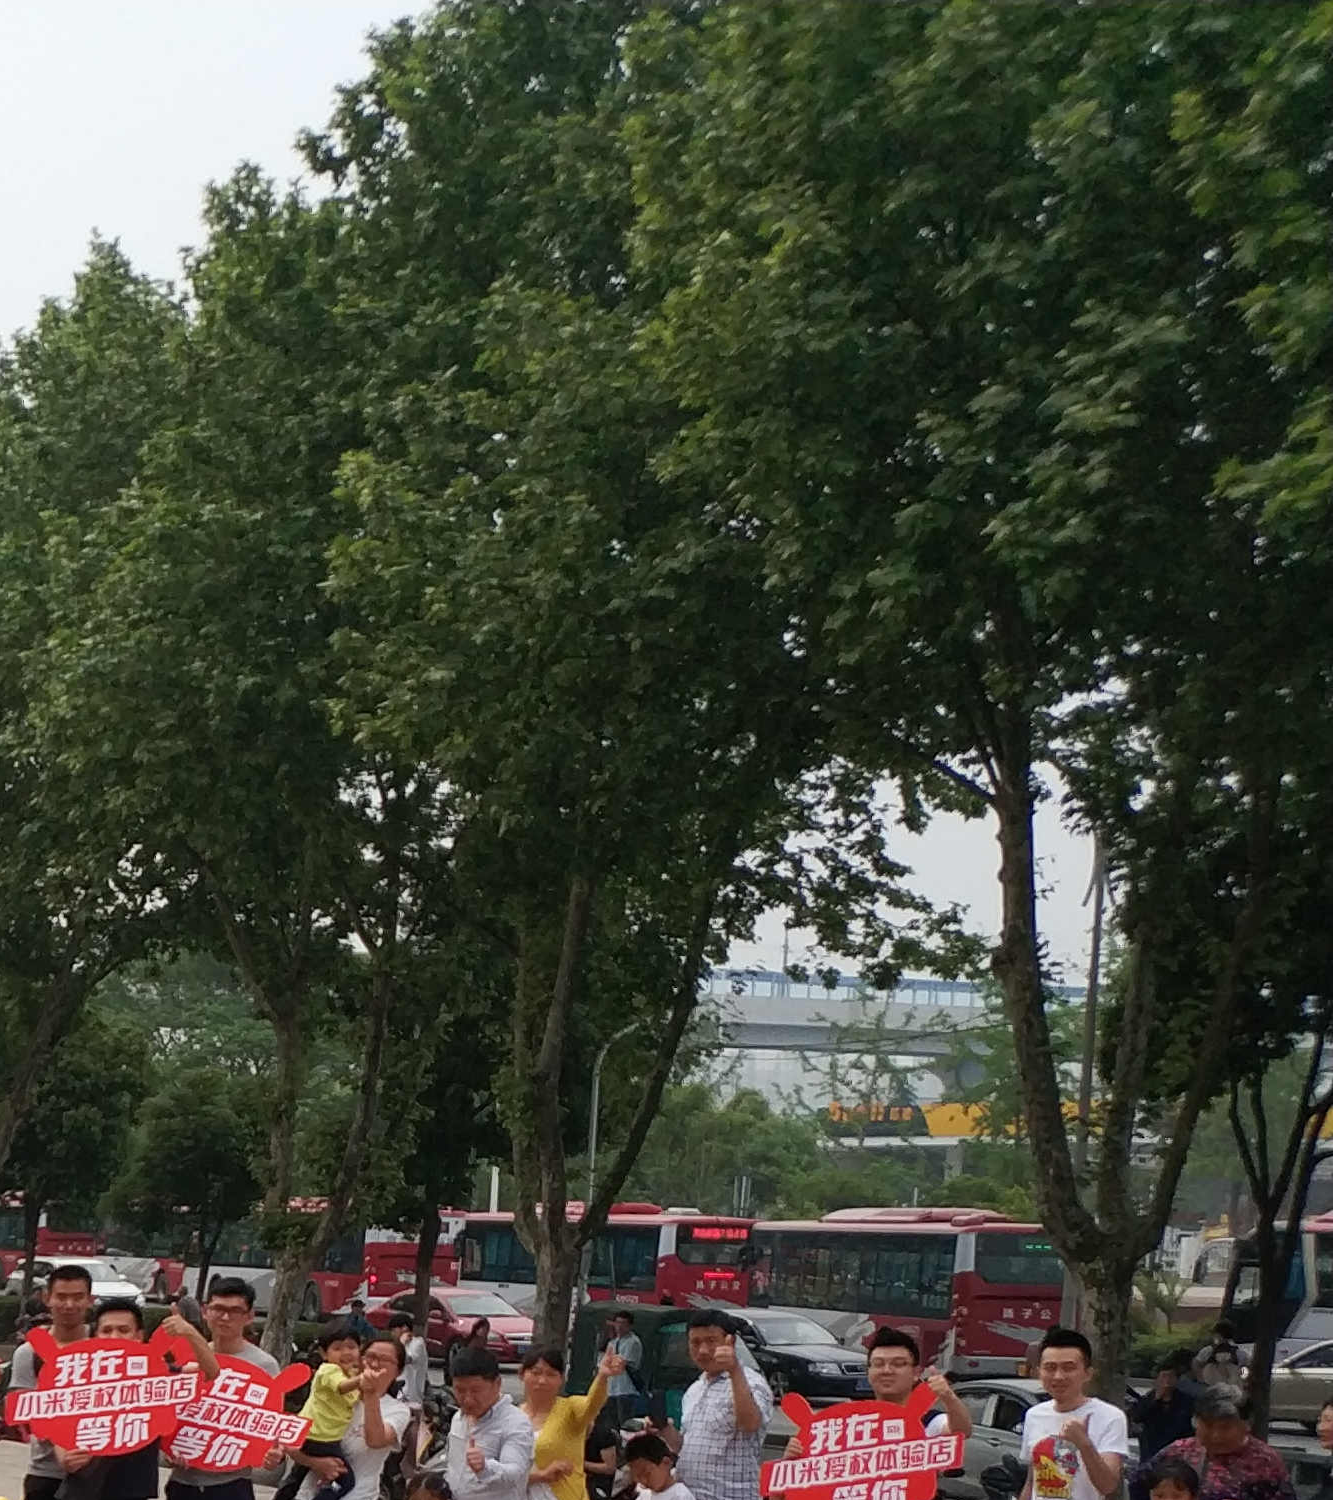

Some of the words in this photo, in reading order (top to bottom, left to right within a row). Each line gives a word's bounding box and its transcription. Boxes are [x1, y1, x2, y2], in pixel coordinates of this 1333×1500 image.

[55, 1349, 125, 1387] 我在
[17, 1375, 195, 1416] 小米授权体验店
[76, 1412, 150, 1450] 等你
[170, 1426, 249, 1467] 等你
[810, 1413, 880, 1454] 我在
[773, 1437, 954, 1488] 小米授权体验店
